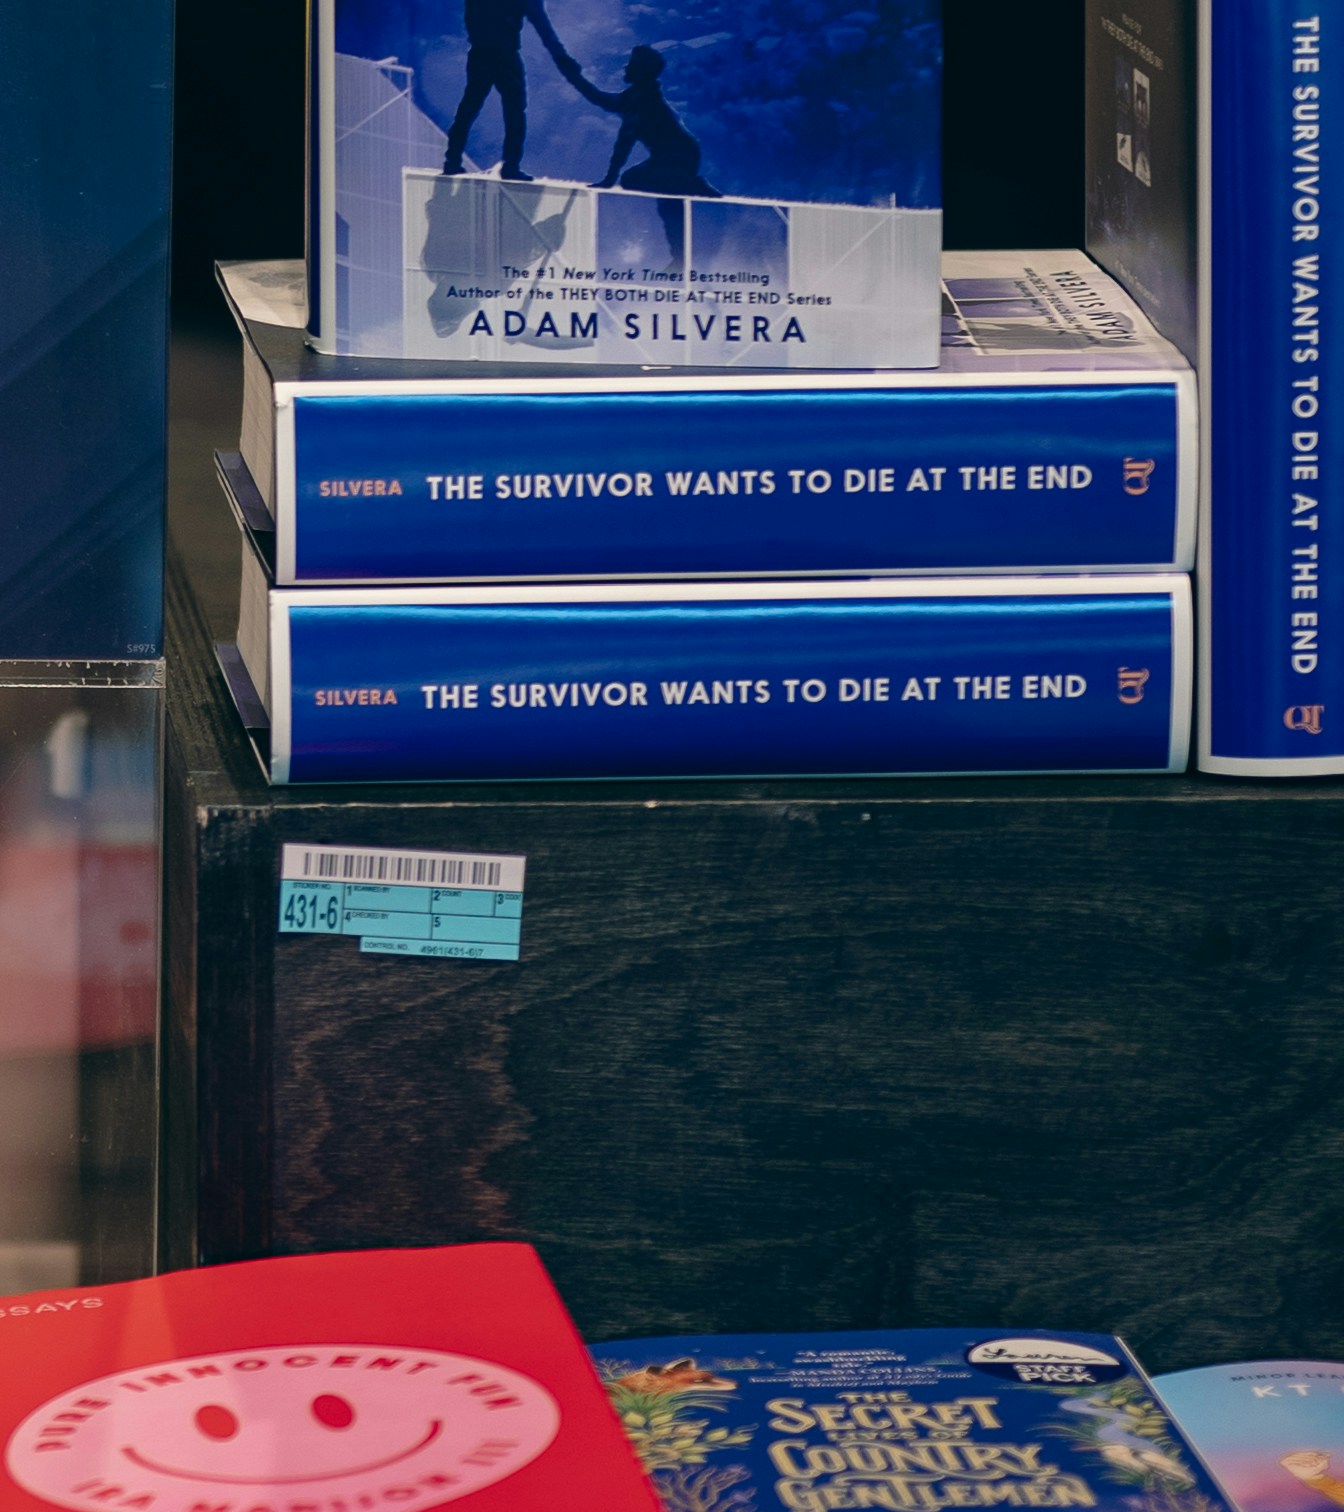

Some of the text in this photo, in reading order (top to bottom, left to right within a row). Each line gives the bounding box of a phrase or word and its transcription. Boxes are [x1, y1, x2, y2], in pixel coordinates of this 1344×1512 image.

[1292, 16, 1320, 73] THE
[1292, 86, 1320, 242] SURVIVOR
[502, 265, 770, 286] The #1 New York Times Bestselling
[446, 285, 832, 307] Author of the THEY BOTH DIE AT THE END Series
[1292, 255, 1320, 364] WANTS
[469, 310, 807, 344] ADAM SILVERA
[1291, 376, 1319, 419] TO
[1291, 432, 1319, 480] DIE
[319, 463, 1093, 501] SILVERA THE SURVIVOR WANTS TO DIE AT THE END
[1291, 493, 1319, 531] AT
[1291, 544, 1319, 600] THE
[1291, 612, 1319, 674] END
[315, 674, 1088, 710] SILVERA THE SURVIVOR WANTS TO DIE AT THE END
[346, 885, 353, 896] 1
[433, 890, 441, 901] 2
[284, 893, 339, 930] 431-6
[344, 912, 352, 923] 4
[434, 916, 441, 927] 5
[1018, 1372, 1098, 1384] PICK
[765, 1397, 1004, 1435] SECRET
[837, 1392, 912, 1405] THE
[767, 1438, 1062, 1481] COUNTRY
